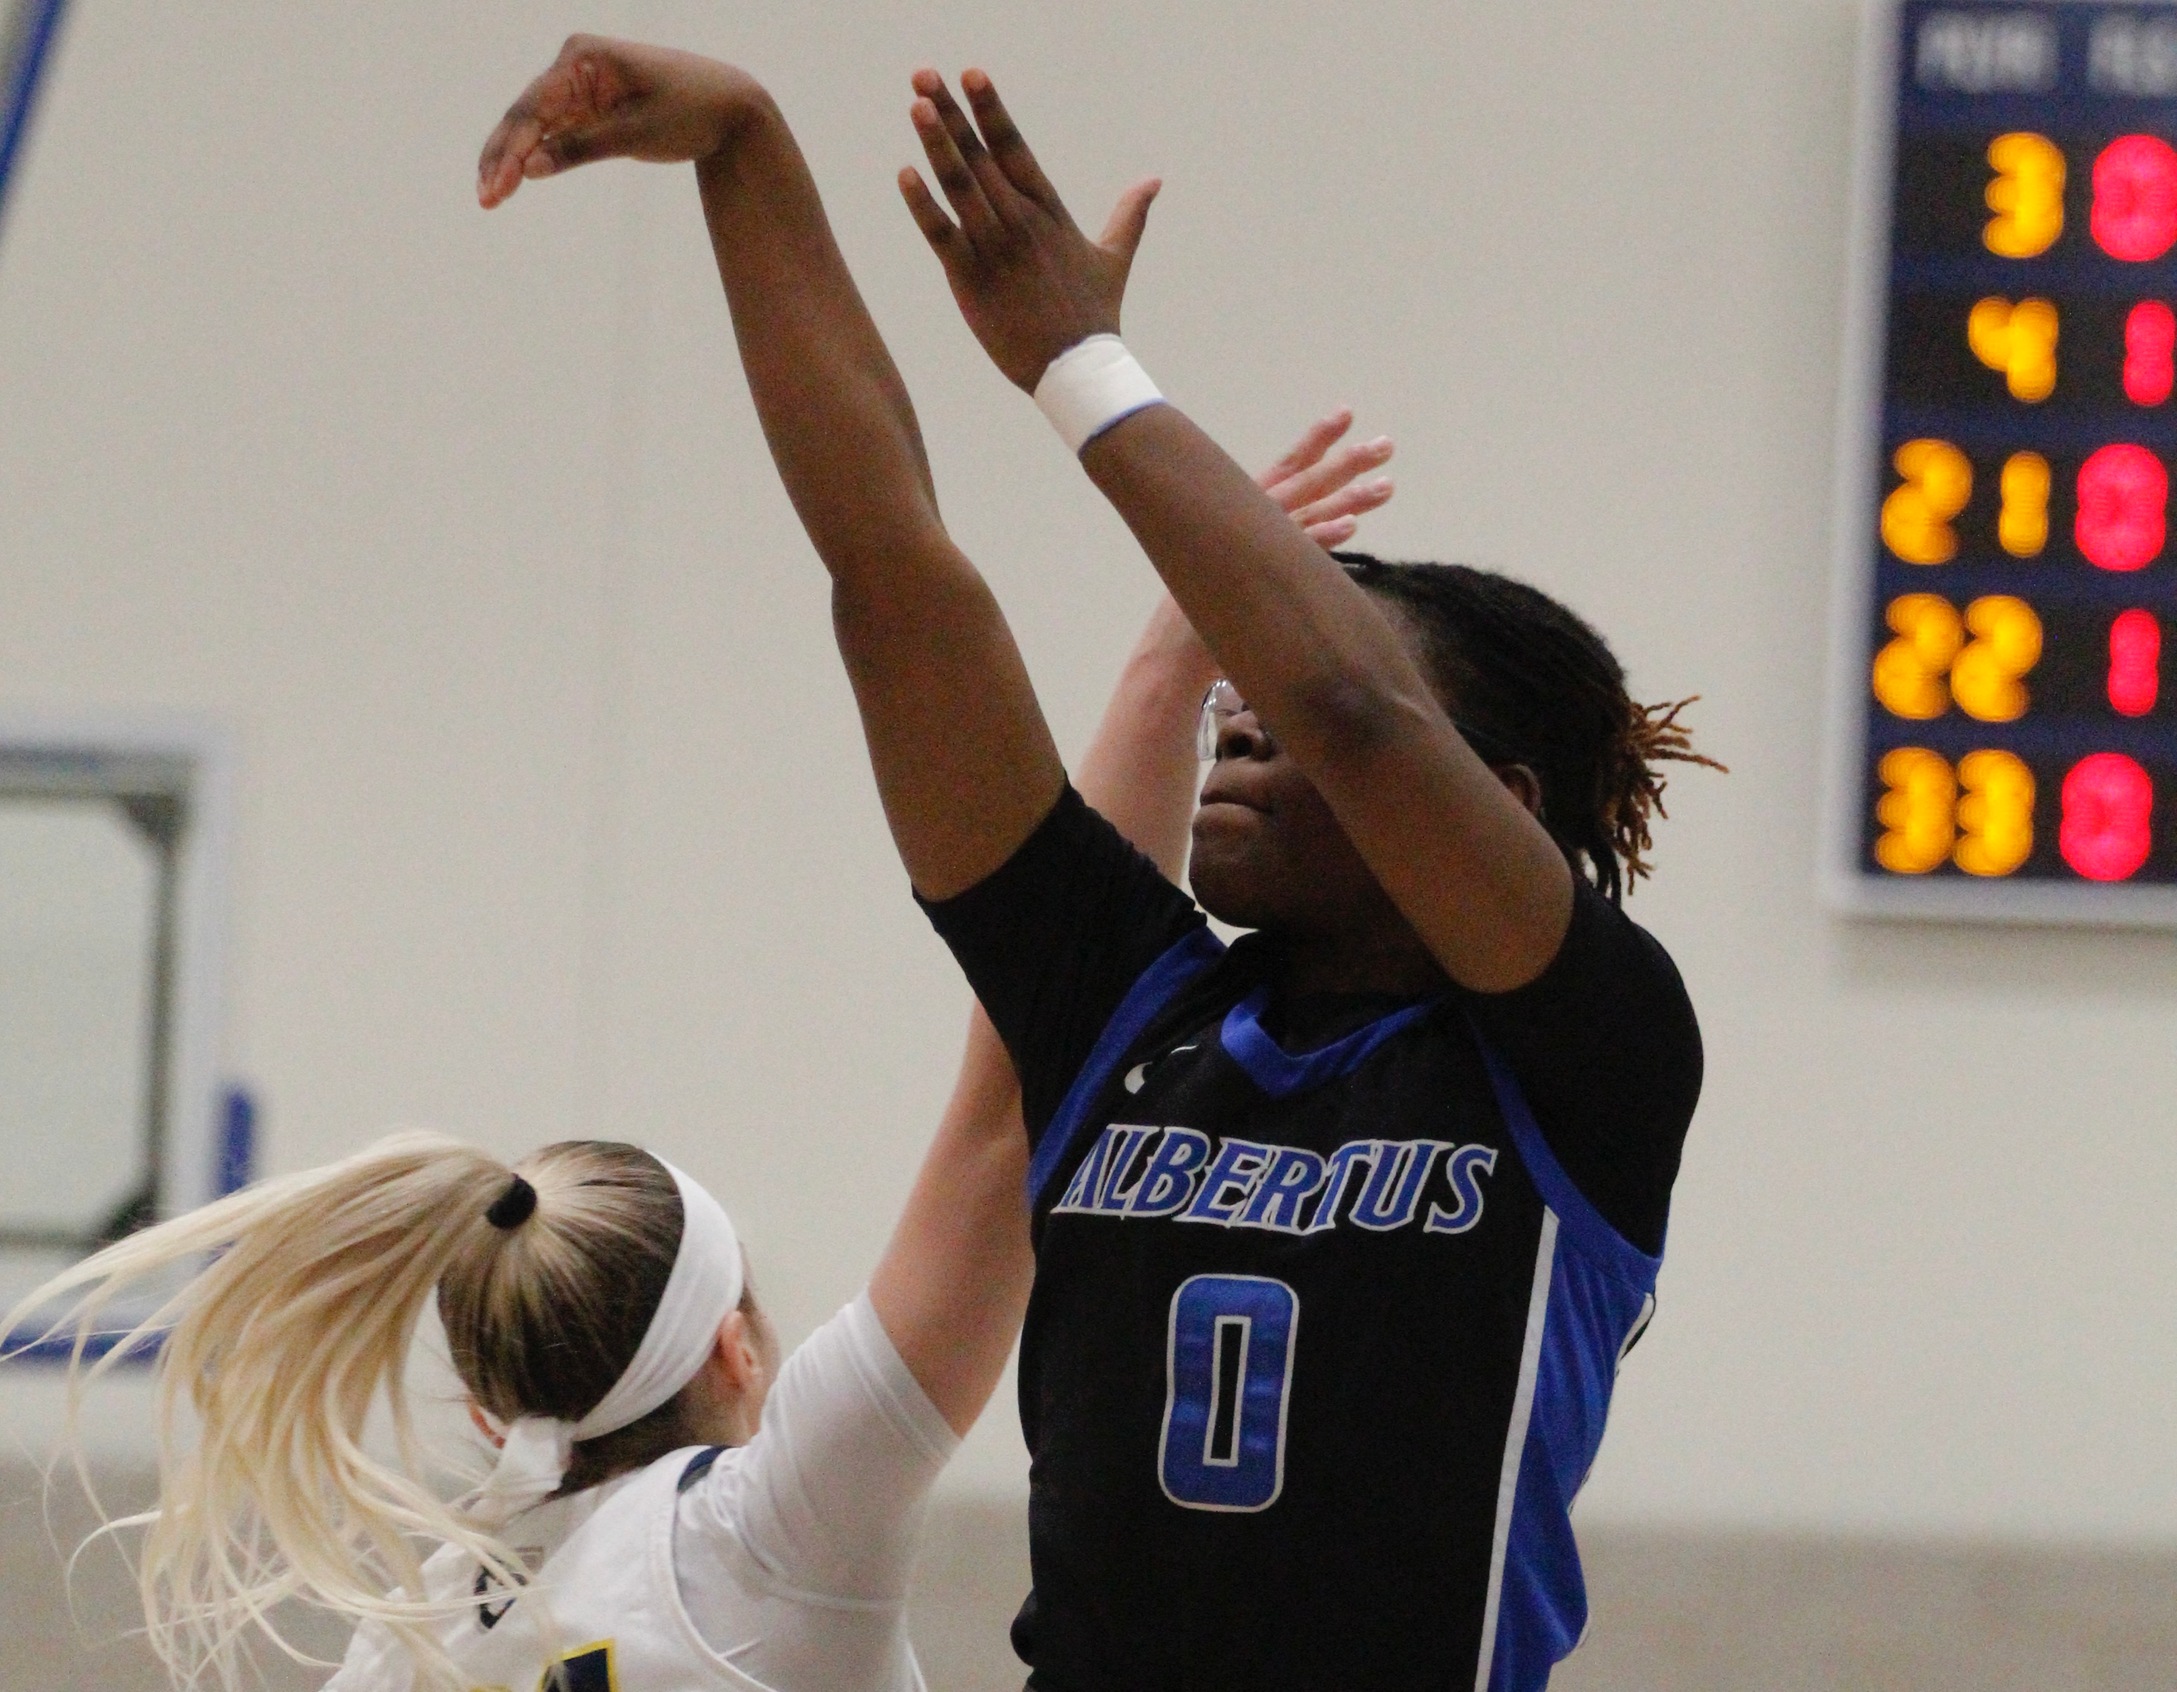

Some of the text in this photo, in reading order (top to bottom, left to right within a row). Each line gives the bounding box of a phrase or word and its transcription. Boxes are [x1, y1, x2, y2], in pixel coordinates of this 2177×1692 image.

[1983, 132, 2177, 262] 3 0
[1968, 297, 2176, 406] 4 1
[1881, 438, 2168, 572] 21 0
[1873, 593, 2160, 722] 22 1
[1875, 747, 2153, 881] 33 0
[1050, 1123, 1499, 1237] ALBERTUS
[1157, 1273, 1300, 1513] 0
